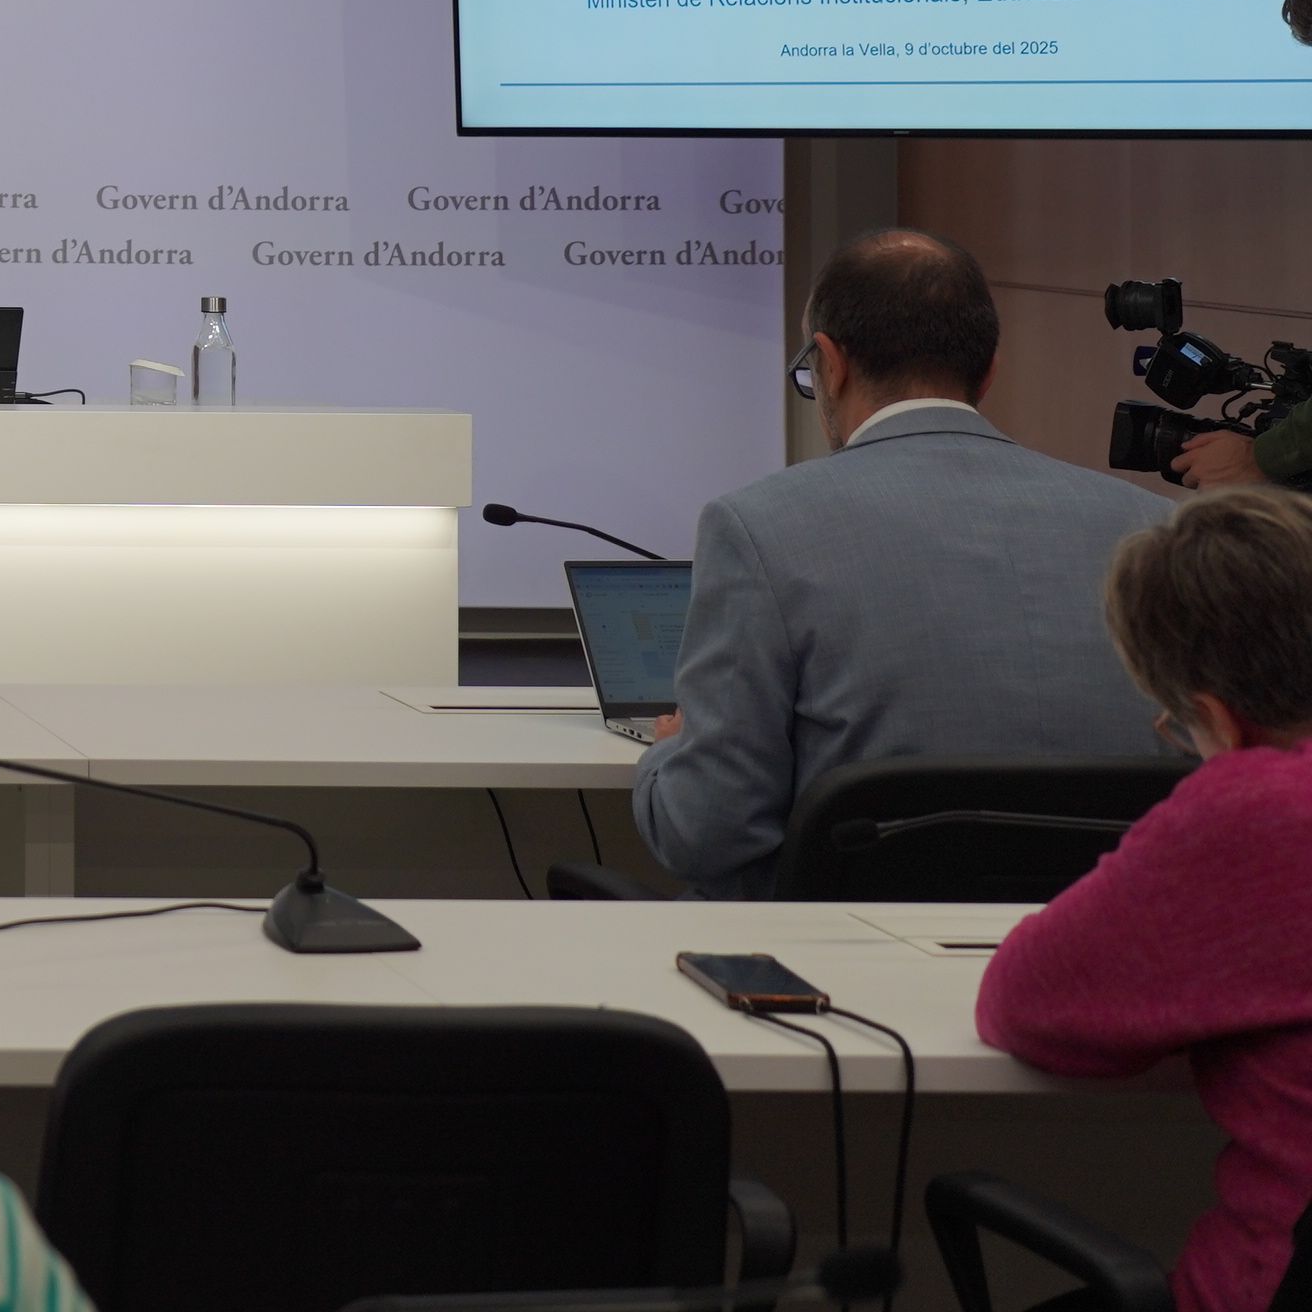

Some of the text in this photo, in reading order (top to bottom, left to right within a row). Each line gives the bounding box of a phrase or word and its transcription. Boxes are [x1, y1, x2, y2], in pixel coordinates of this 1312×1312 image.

[780, 40, 1059, 59] Andorra la Vella, 9 d'octubre del 2025
[96, 184, 351, 212] Govern d’Andorra
[407, 185, 662, 212] Govern d’Andorra
[719, 189, 784, 215] Gove
[51, 238, 195, 266] d’Andorra
[252, 240, 507, 267] Govern d’Andorra
[563, 239, 784, 266] Govern d’Andor
